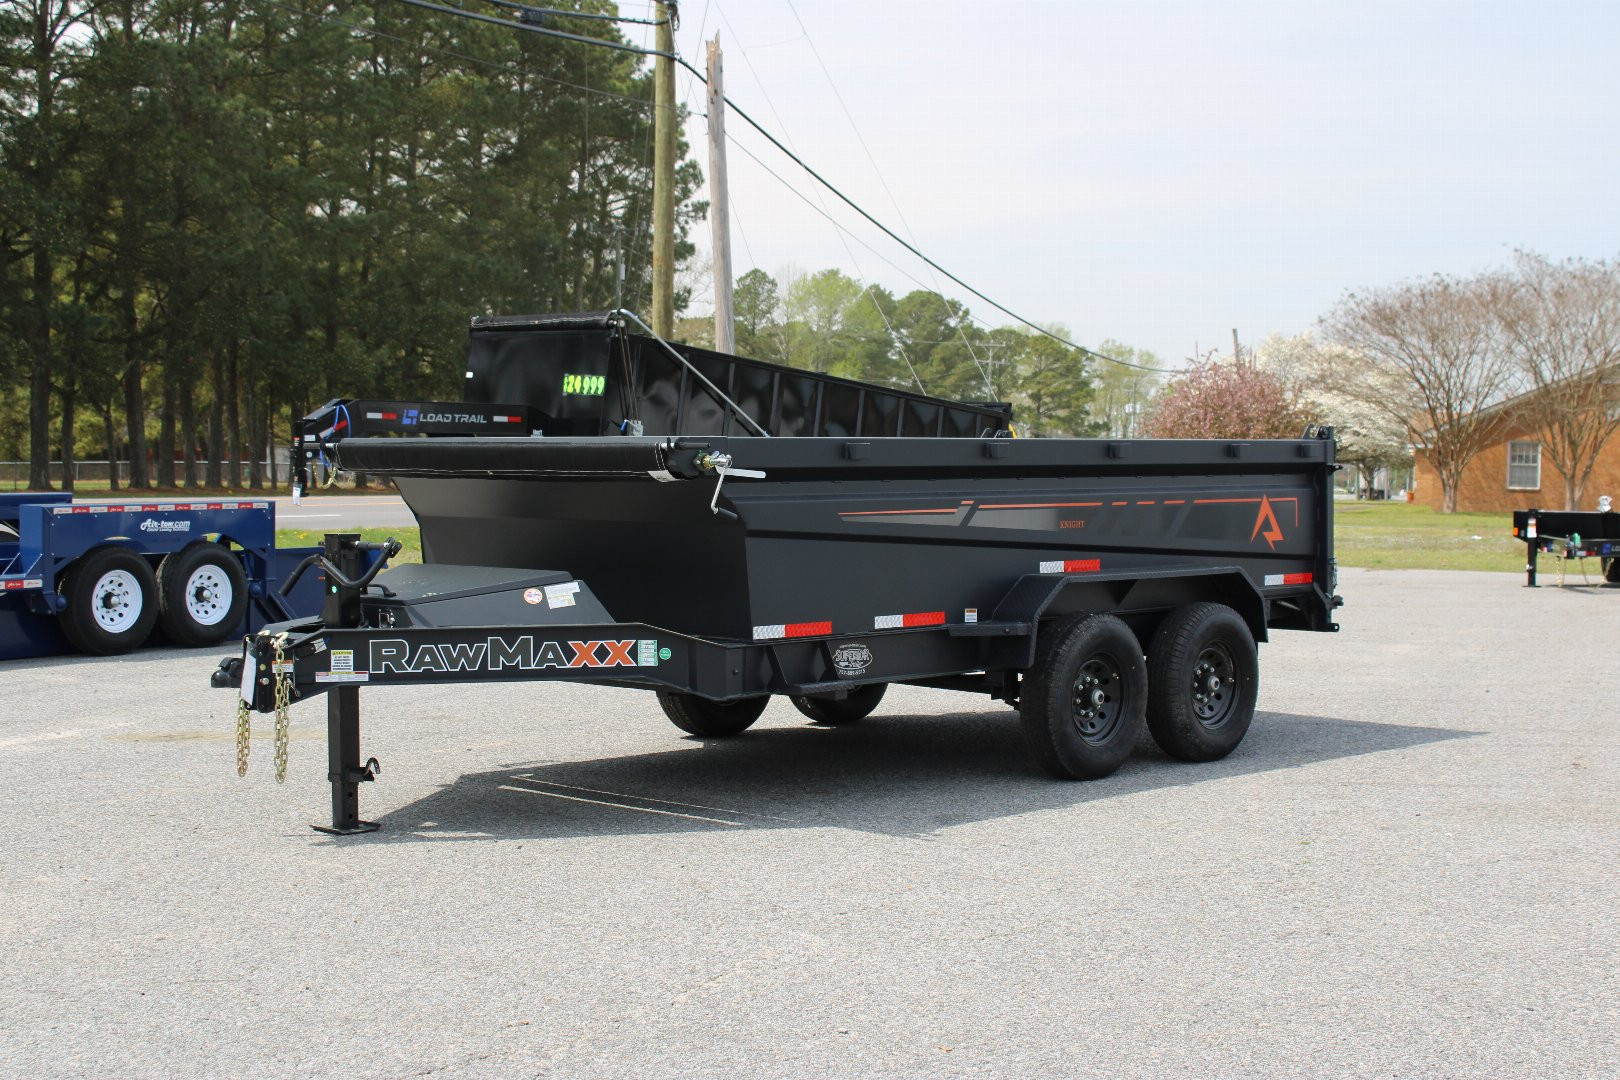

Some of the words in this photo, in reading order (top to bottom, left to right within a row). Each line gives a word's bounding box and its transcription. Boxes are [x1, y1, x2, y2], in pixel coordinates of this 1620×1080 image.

[419, 413, 452, 423] LOAD
[454, 414, 488, 424] TRAIL
[1059, 520, 1085, 529] KNIGHT
